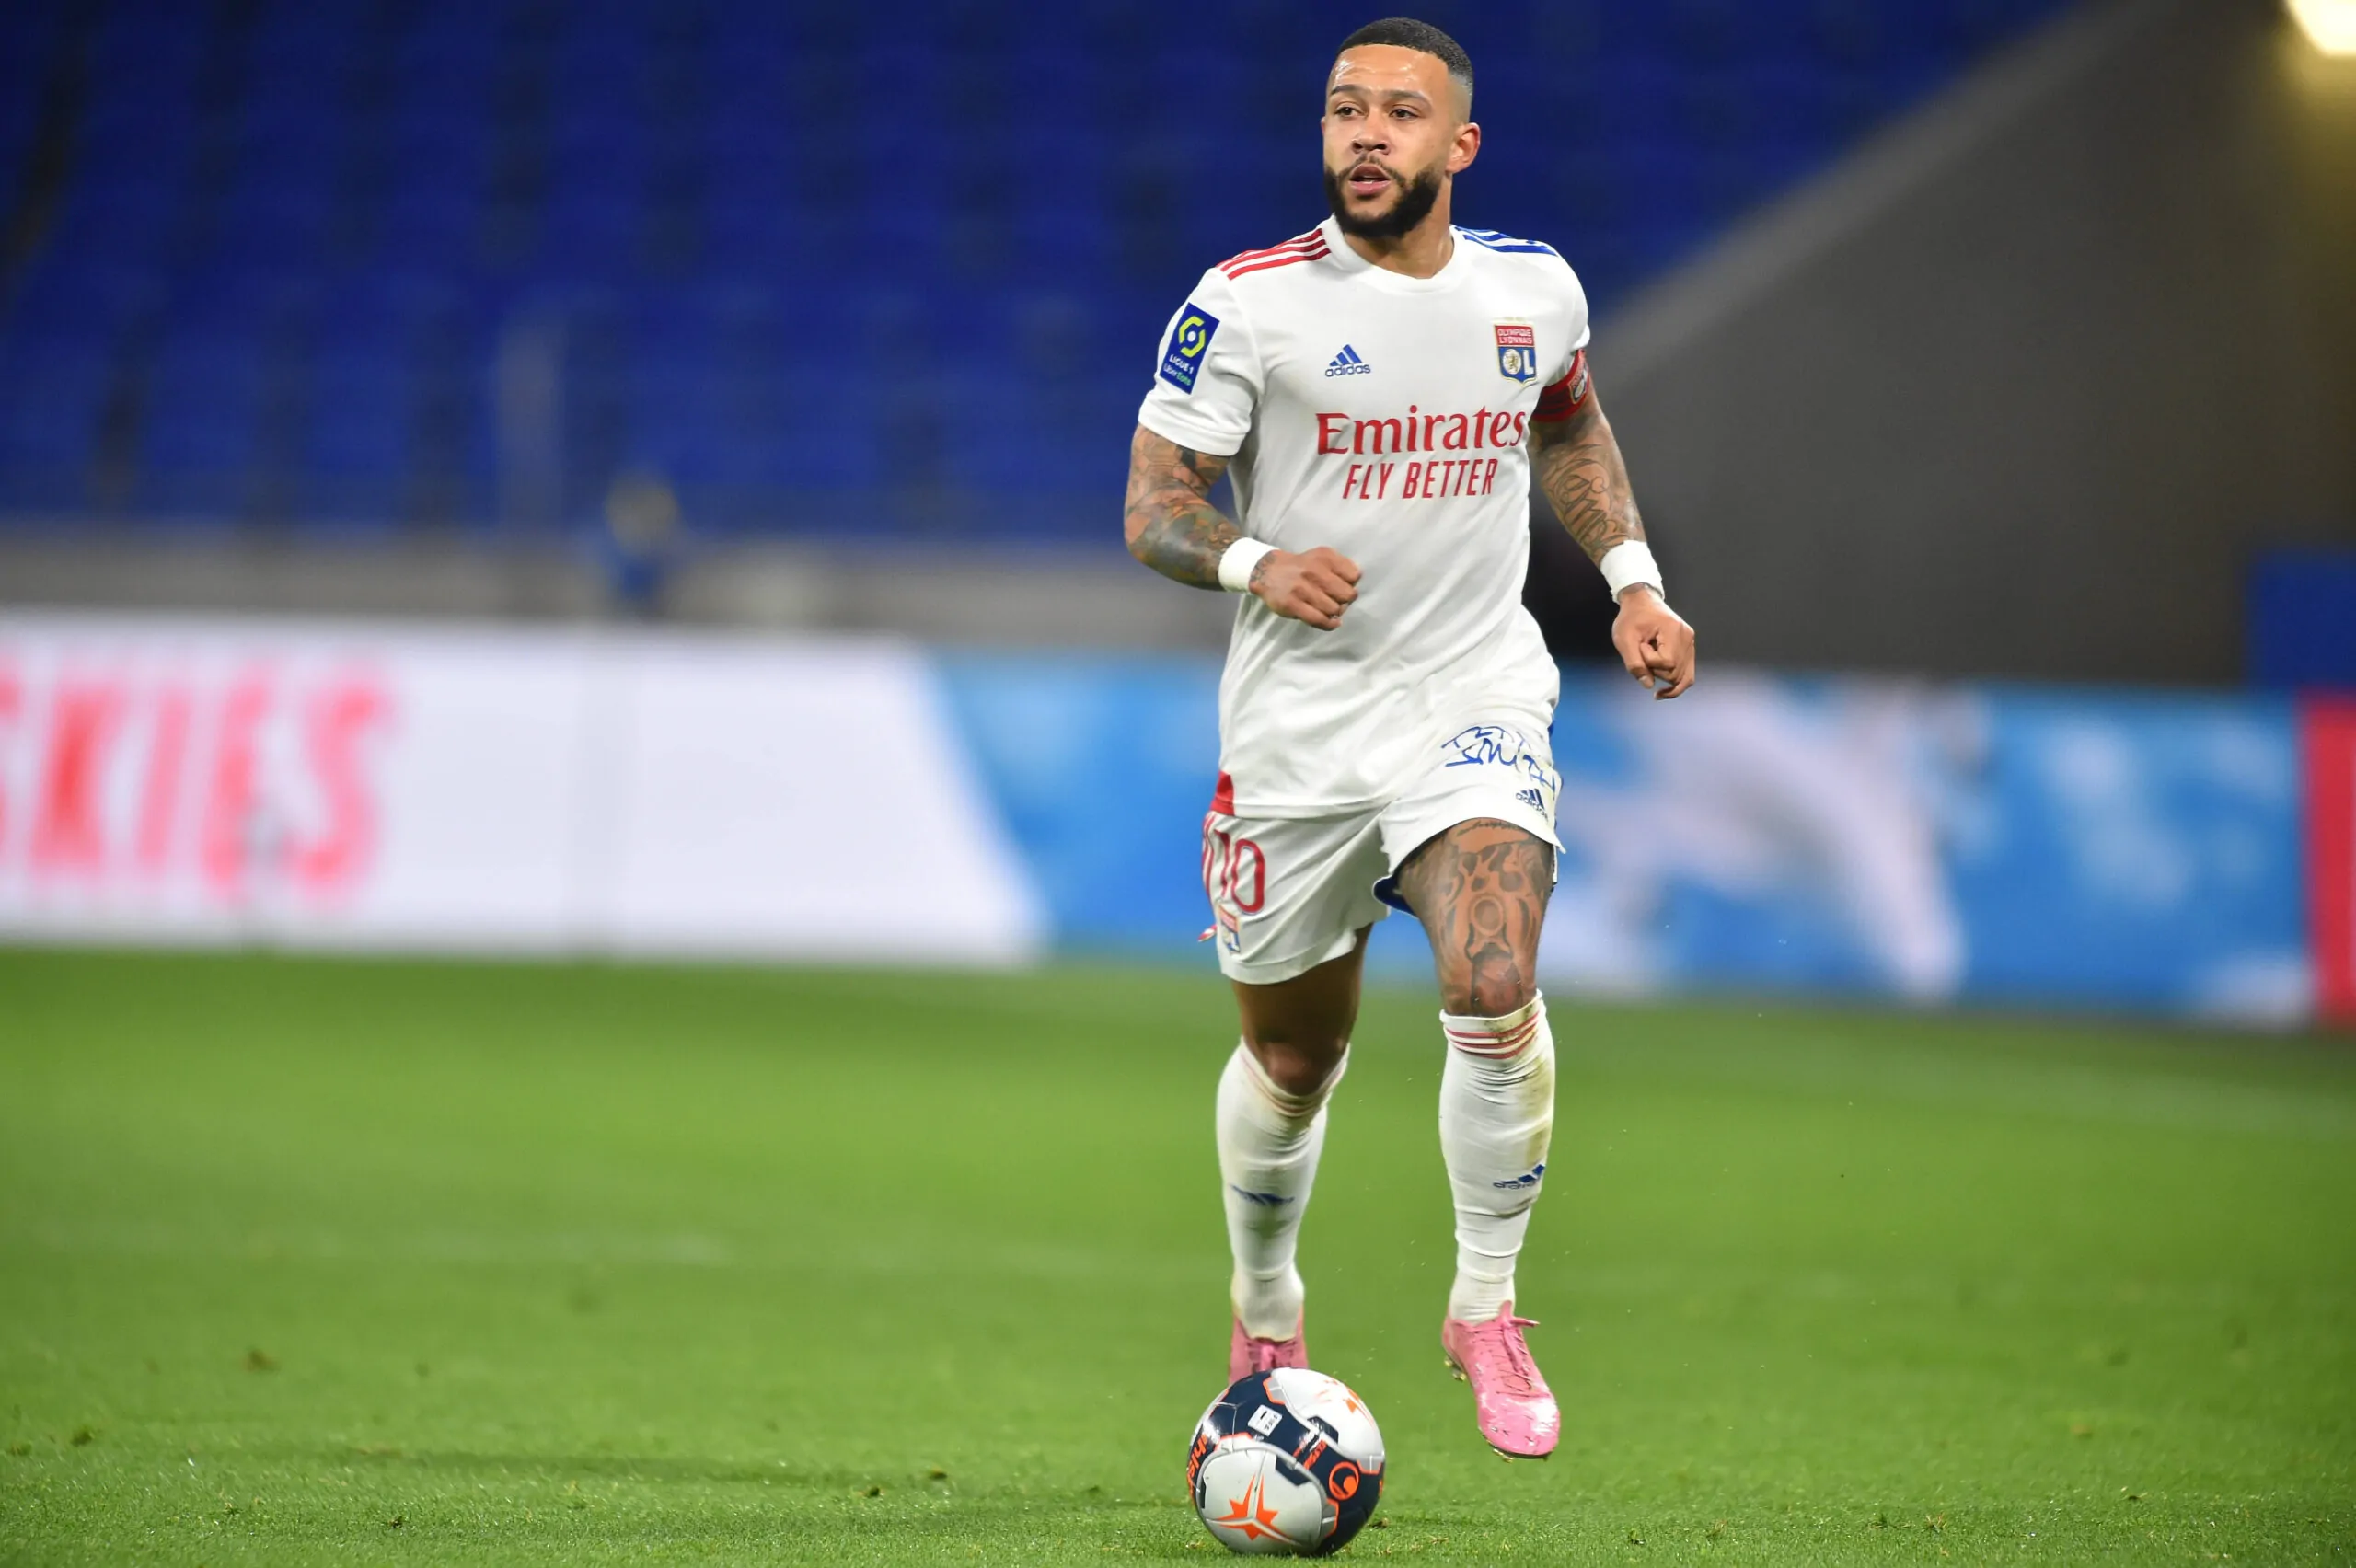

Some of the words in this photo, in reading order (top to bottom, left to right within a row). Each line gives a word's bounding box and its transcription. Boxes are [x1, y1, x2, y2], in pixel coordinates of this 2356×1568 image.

[1325, 363, 1370, 377] adidas
[1315, 405, 1526, 455] Emirates
[1343, 463, 1394, 499] FLY
[1403, 458, 1498, 499] BETTER
[1214, 829, 1265, 914] 10
